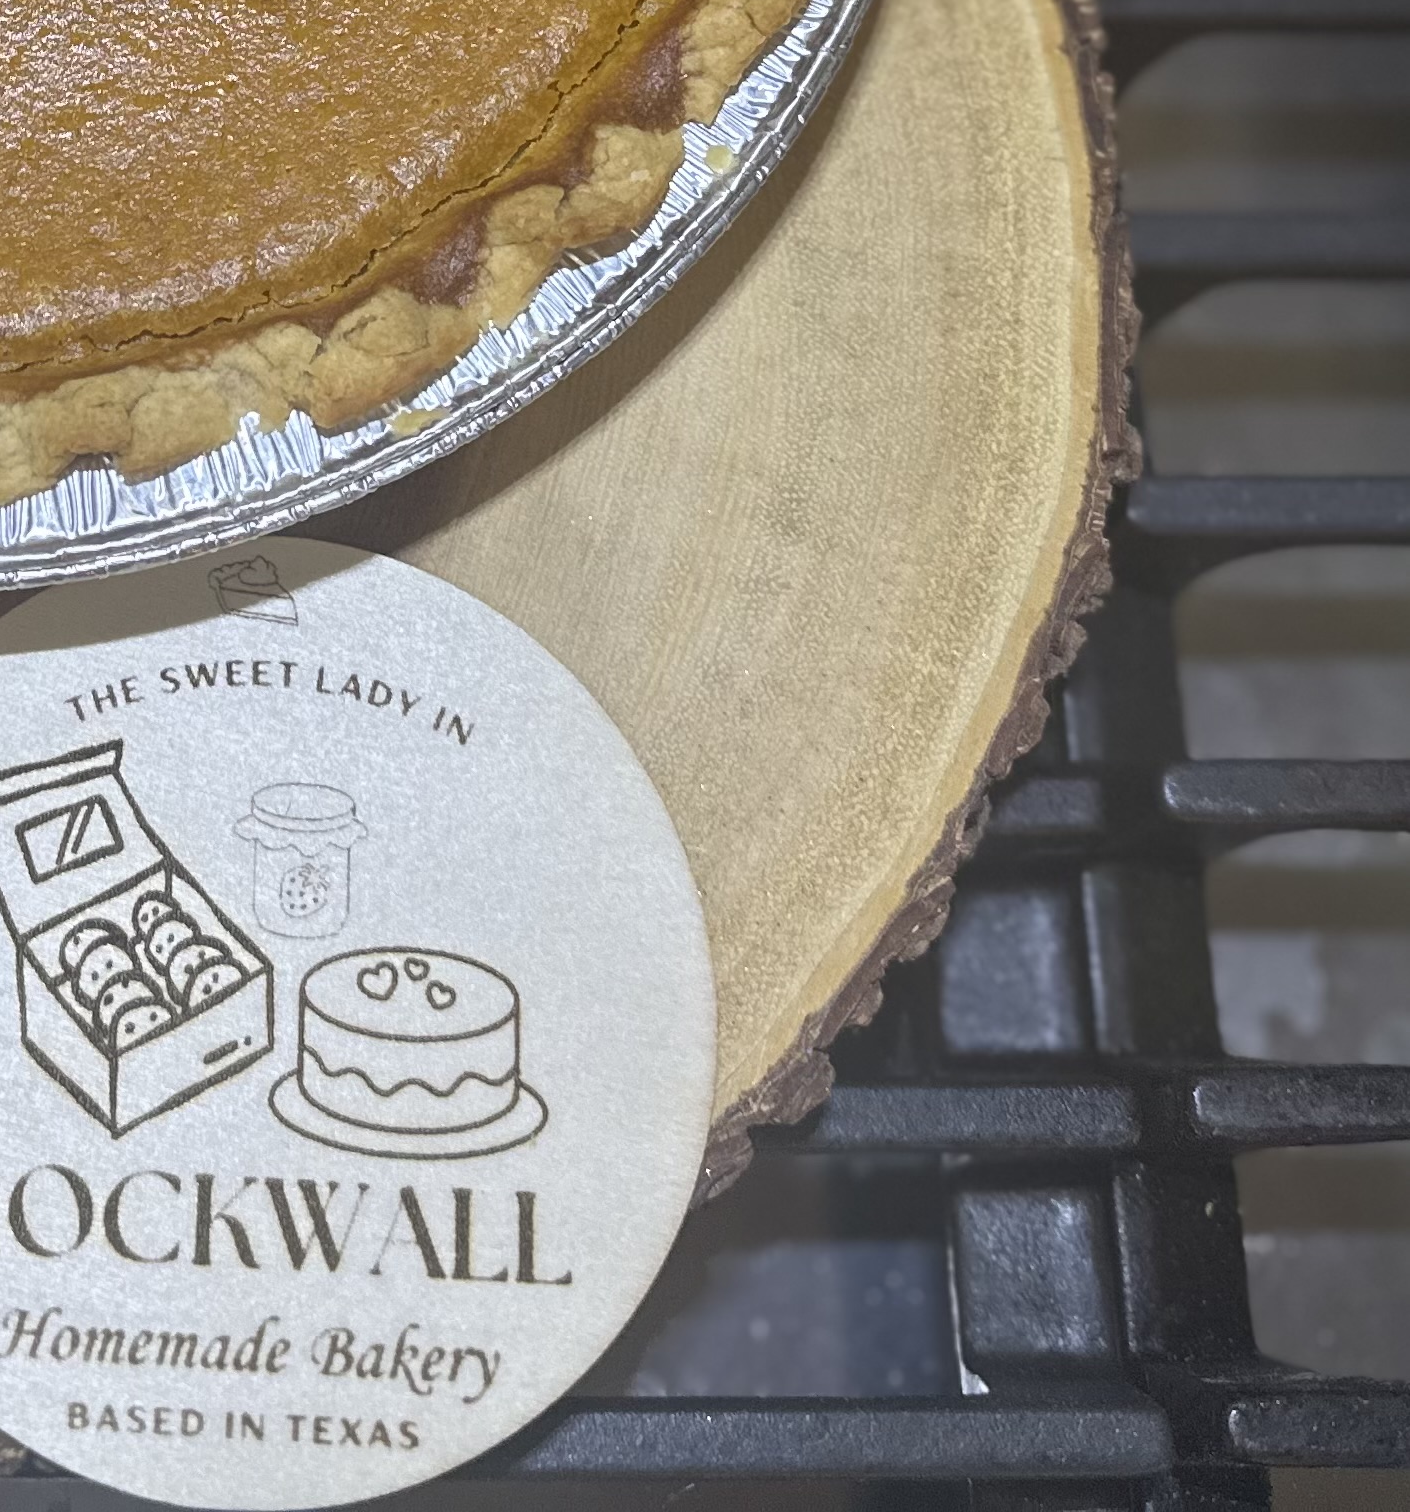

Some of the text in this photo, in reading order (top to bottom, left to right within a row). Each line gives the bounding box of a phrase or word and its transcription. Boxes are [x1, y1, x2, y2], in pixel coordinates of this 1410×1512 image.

[64, 660, 476, 747] THE SWEET LADY IN
[309, 1324, 502, 1404] Bakery
[66, 1402, 421, 1451] BASED IN TEXAS
